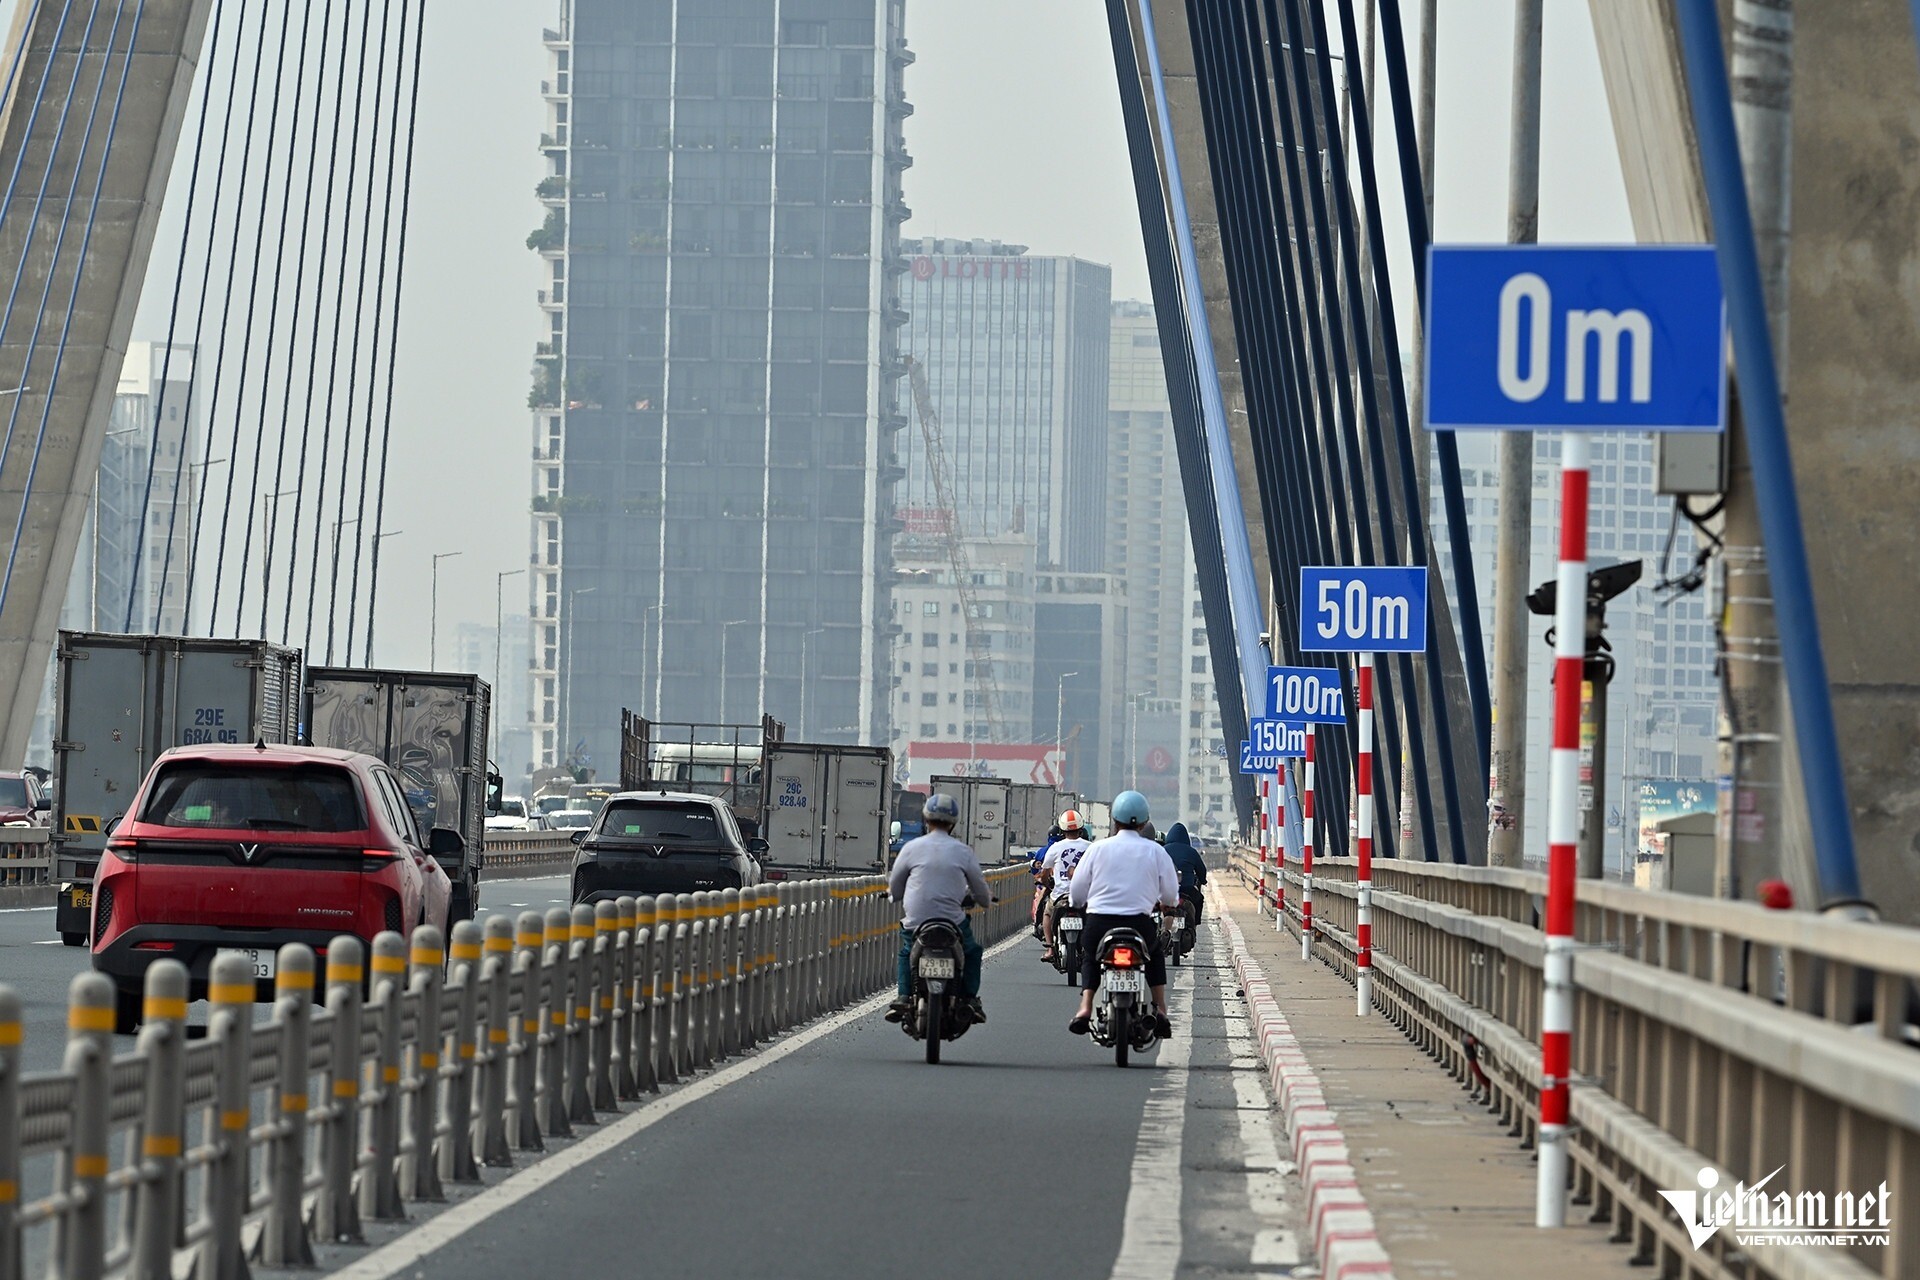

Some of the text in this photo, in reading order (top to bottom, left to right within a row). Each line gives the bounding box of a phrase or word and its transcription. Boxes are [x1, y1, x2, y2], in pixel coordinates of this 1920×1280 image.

[941, 258, 1030, 280] LOTTE
[1497, 272, 1652, 403] 0m
[1317, 579, 1409, 639] 50m
[1272, 674, 1346, 717] 100m
[194, 708, 224, 726] 29E
[1253, 722, 1306, 752] 150m
[779, 795, 807, 807] 928.48
[785, 782, 802, 794] 29C
